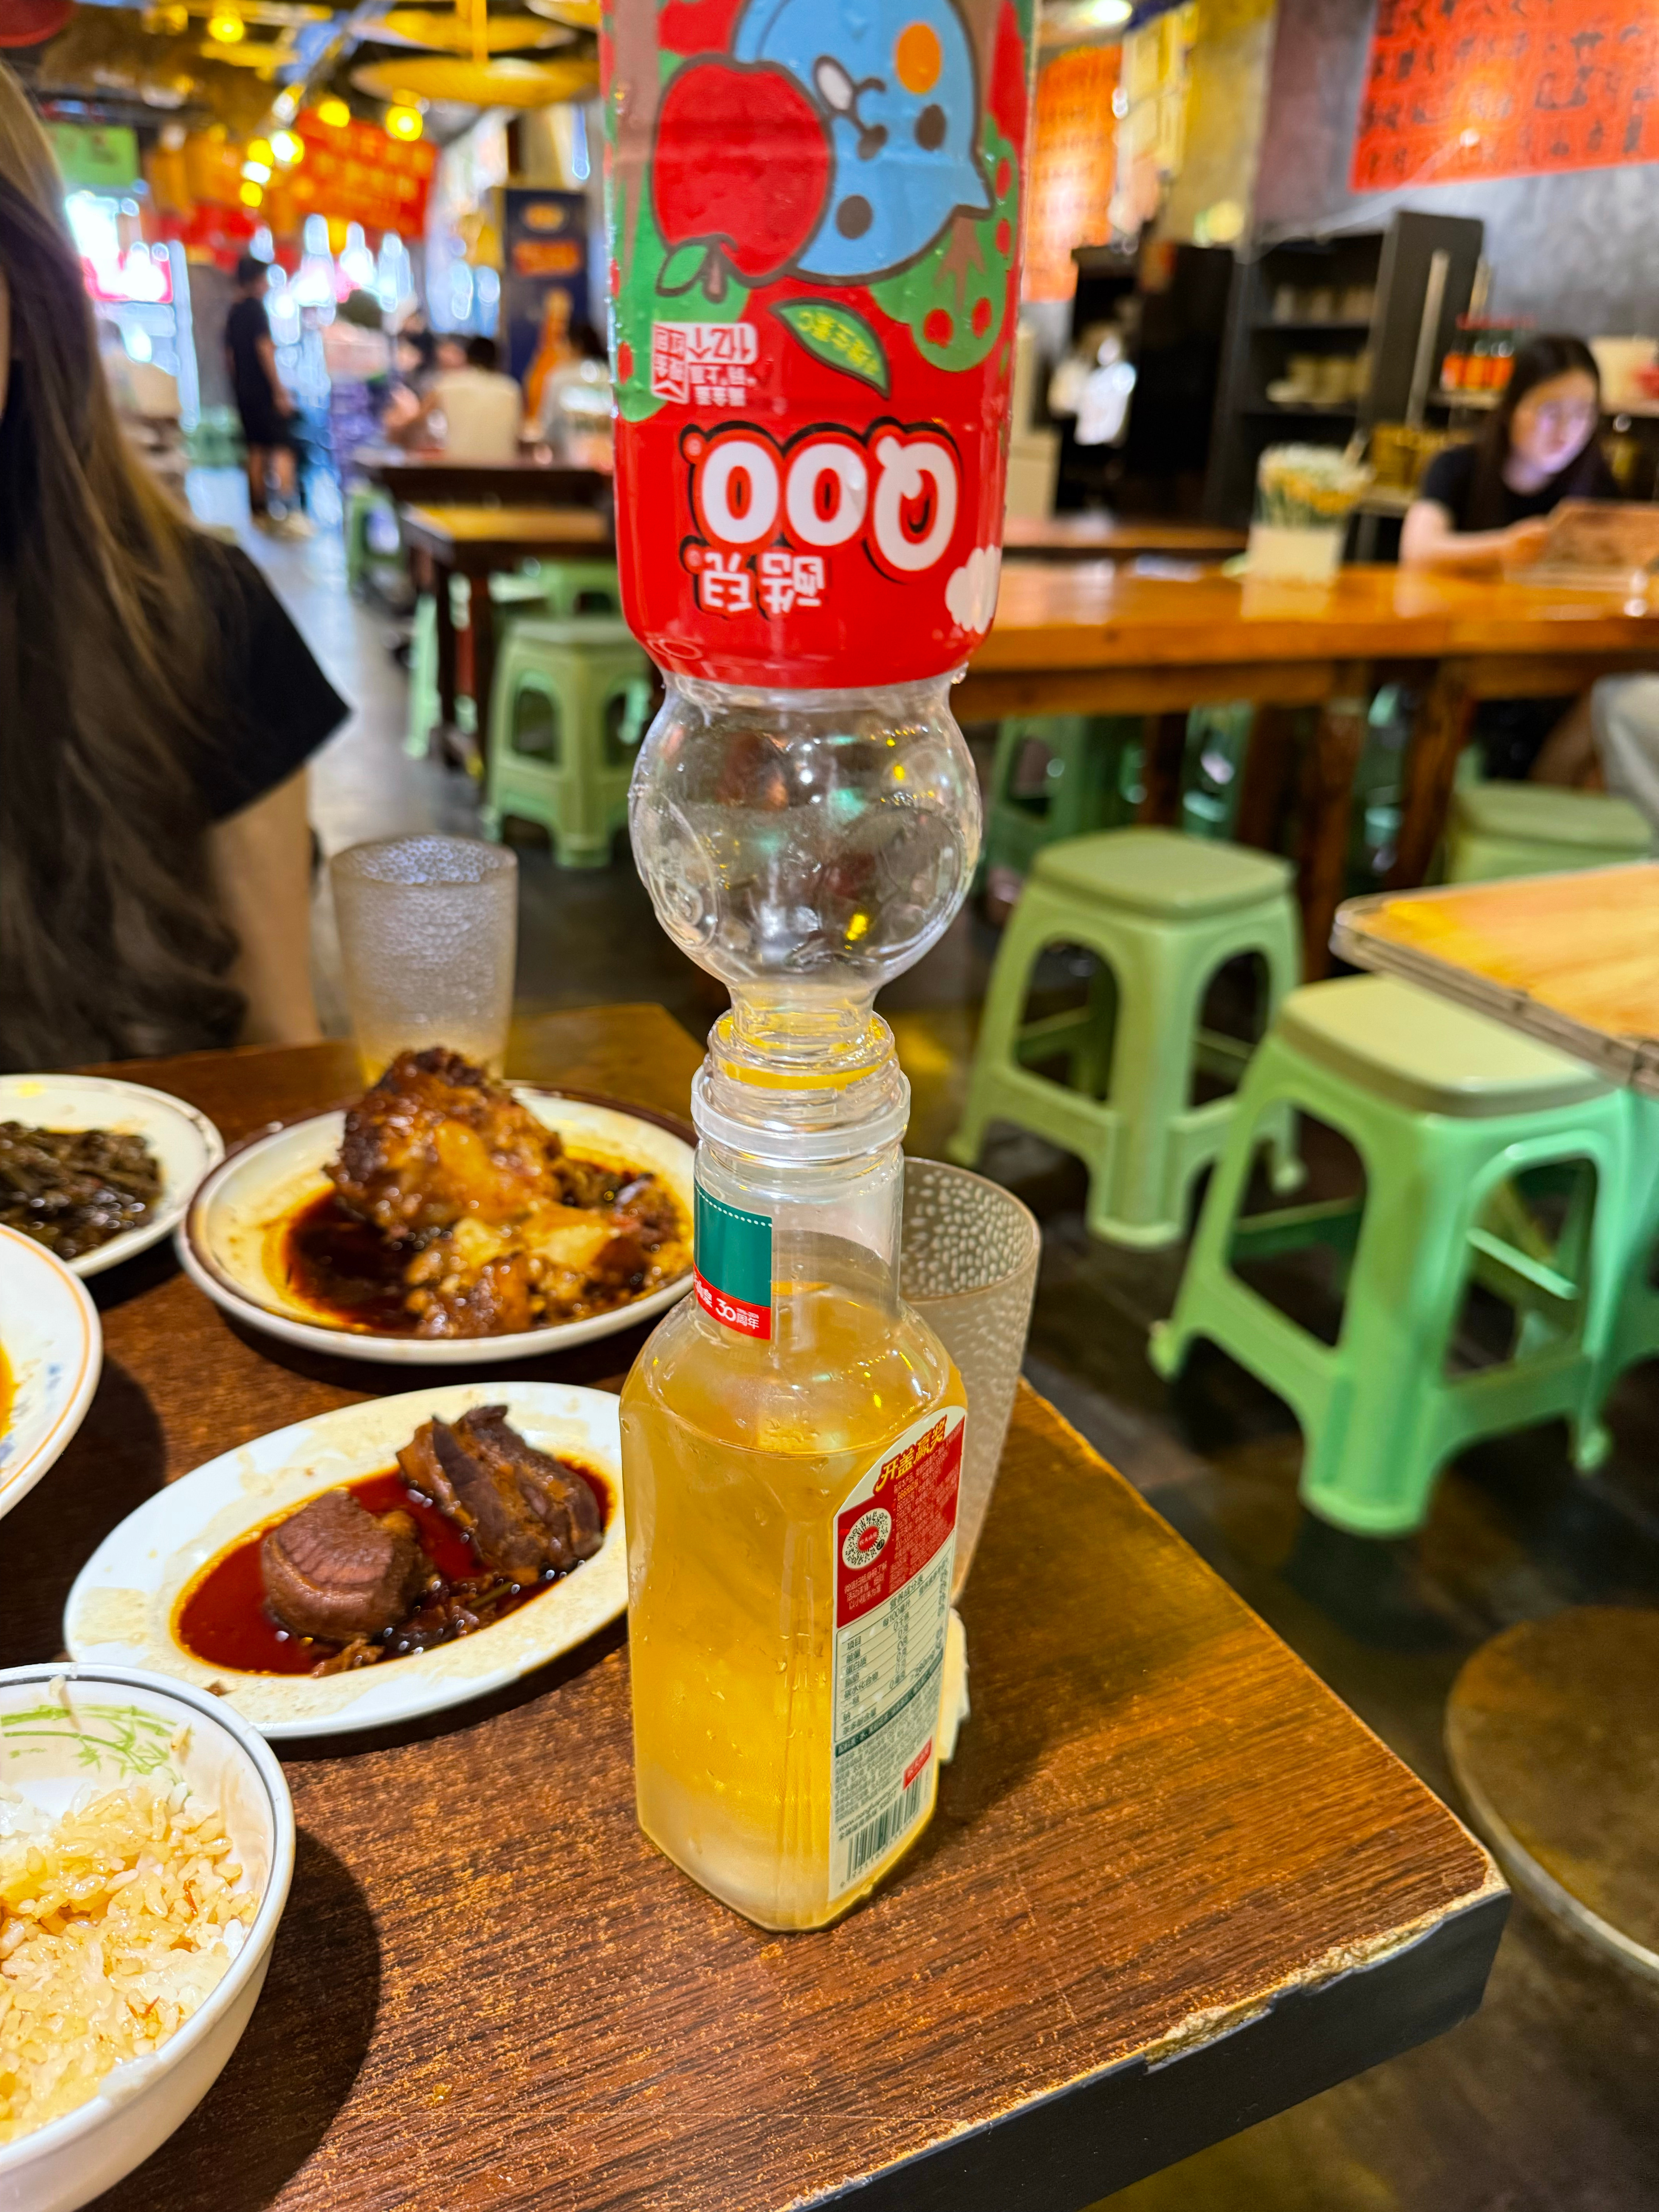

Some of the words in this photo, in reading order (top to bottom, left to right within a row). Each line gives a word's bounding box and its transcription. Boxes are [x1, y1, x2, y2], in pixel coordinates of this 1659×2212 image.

[688, 327, 750, 361] 1亿个
[701, 435, 958, 572] Qoo
[703, 552, 825, 613] 酷兒
[876, 1419, 946, 1492] 开盖赢奖
[890, 1574, 923, 1609] 营养成分表
[846, 1648, 861, 1663] 能量
[847, 1636, 861, 1650] 项目
[845, 1656, 867, 1674] 蛋白质
[845, 1671, 859, 1686] 脂肪
[844, 1671, 878, 1698] 碳水化合物
